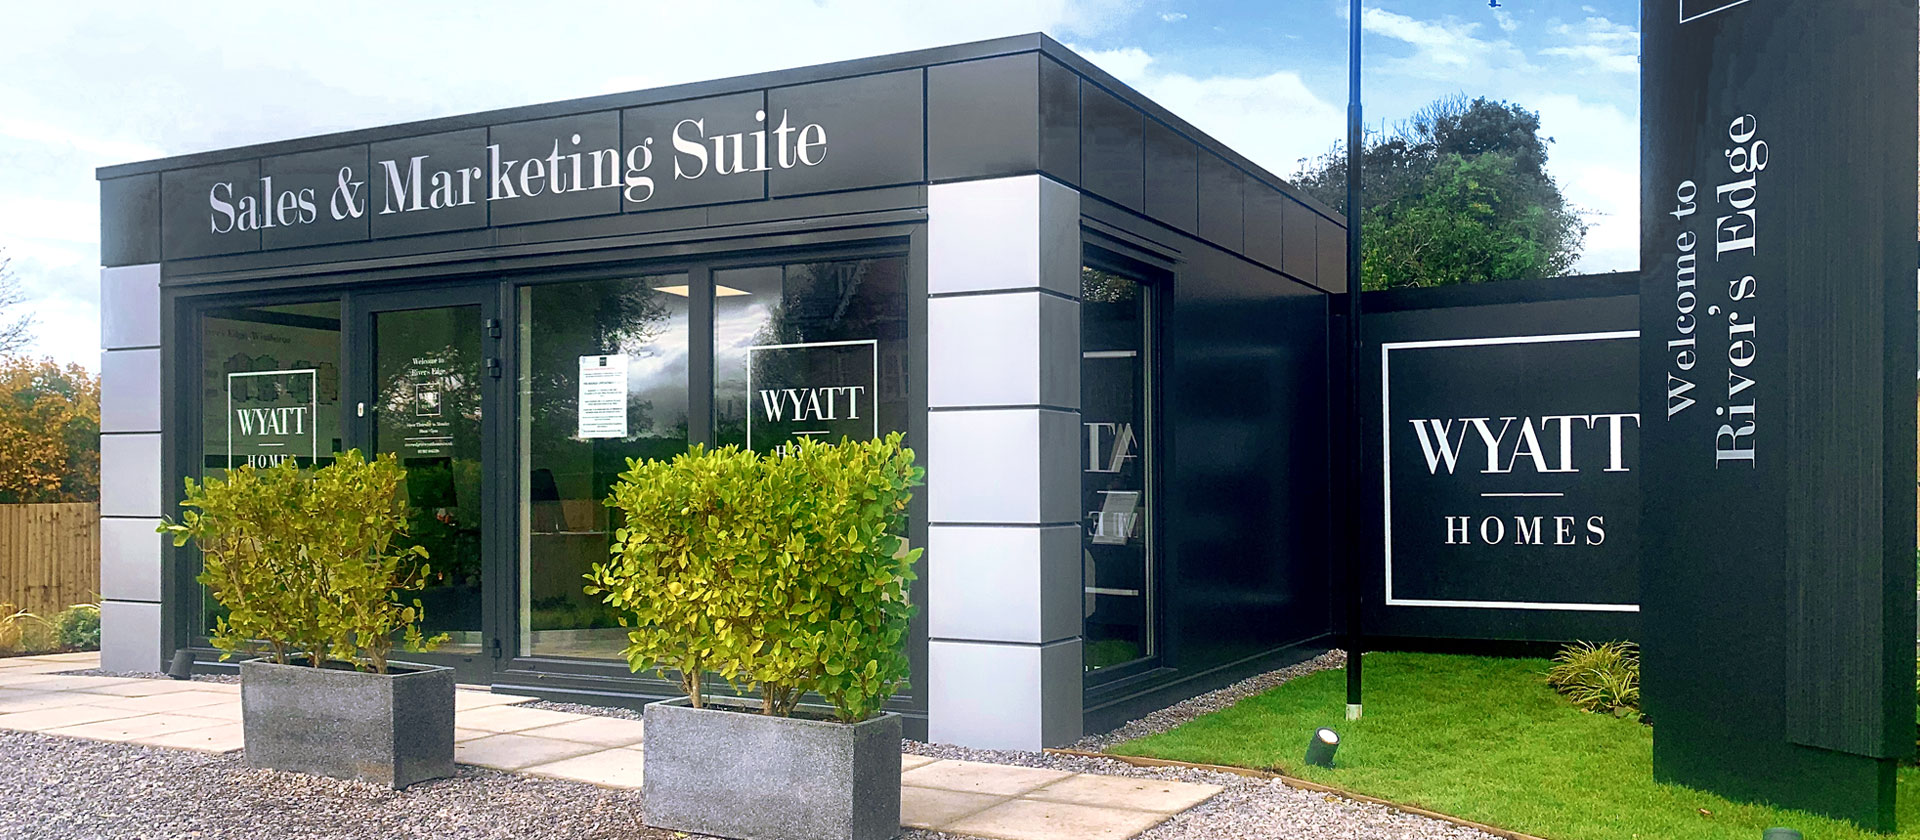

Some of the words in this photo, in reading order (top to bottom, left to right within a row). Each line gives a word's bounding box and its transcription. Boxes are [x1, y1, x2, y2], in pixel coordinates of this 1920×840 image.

[209, 176, 317, 234] Sales
[330, 166, 365, 221] &
[378, 133, 655, 216] Marketing
[671, 108, 828, 181] Suite
[1669, 179, 1697, 220] to
[1716, 113, 1769, 262] Edge
[1667, 230, 1697, 421] Welcome
[1707, 275, 1757, 469] River's
[236, 406, 308, 436] WYATT
[758, 385, 865, 422] WYATT
[1408, 413, 1640, 475] WYATT
[1444, 515, 1605, 546] HOMES
